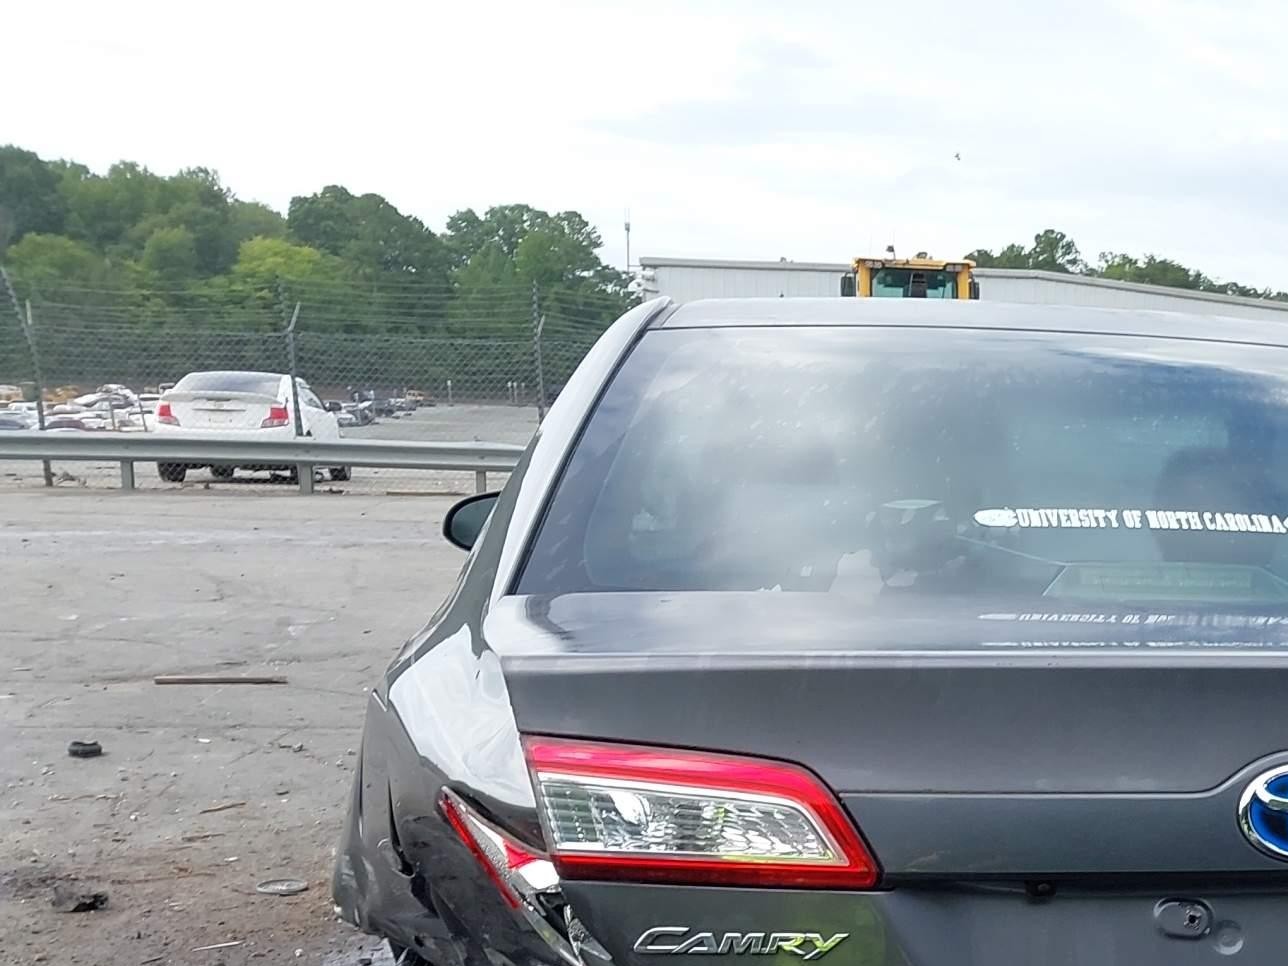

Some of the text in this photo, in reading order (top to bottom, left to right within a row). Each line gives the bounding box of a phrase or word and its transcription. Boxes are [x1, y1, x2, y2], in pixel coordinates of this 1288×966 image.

[1016, 508, 1287, 534] UNIVERSITY OF NORTH CAROLINA
[633, 926, 849, 960] CAMRY
